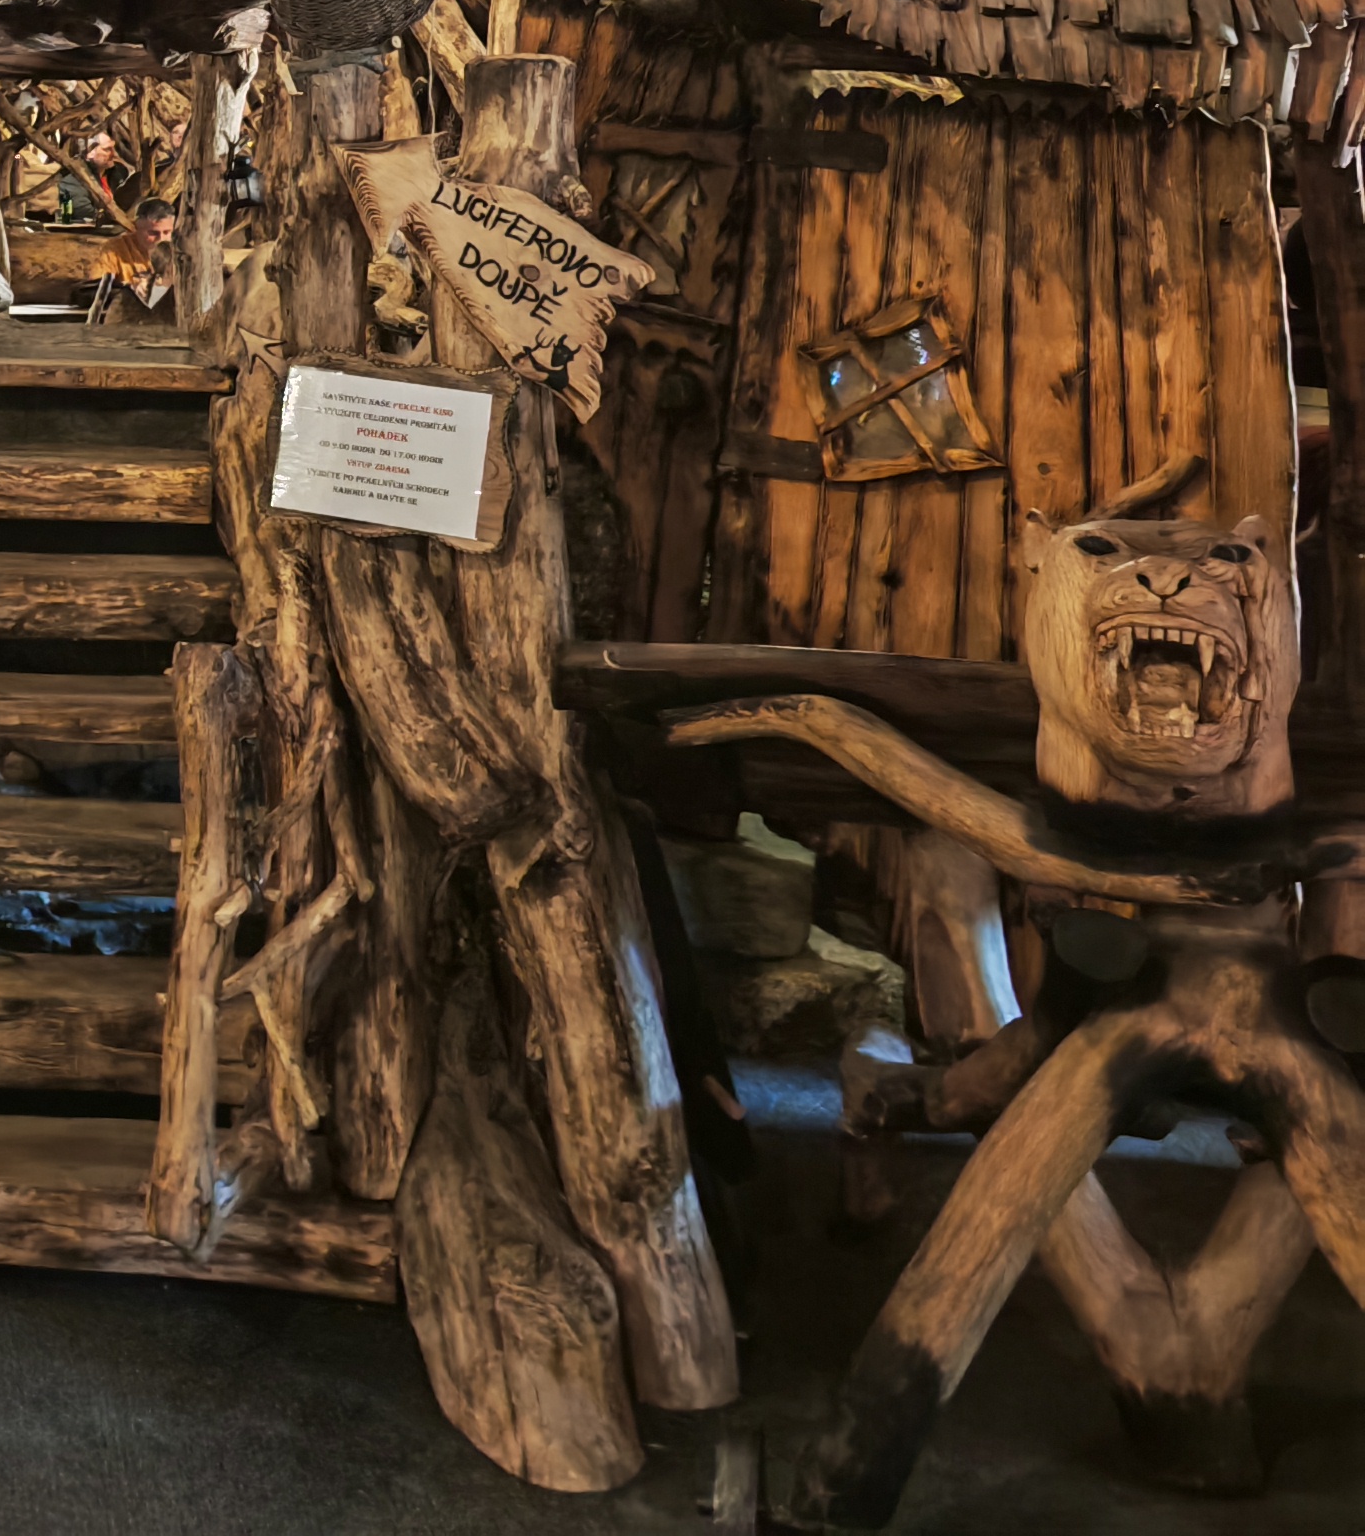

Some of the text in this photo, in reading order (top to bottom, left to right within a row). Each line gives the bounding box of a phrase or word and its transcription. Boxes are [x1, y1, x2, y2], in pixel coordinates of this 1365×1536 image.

[431, 182, 603, 288] LUCIFEROVO
[458, 242, 569, 325] DOUPĚ
[374, 463, 411, 475] ZDARMA
[368, 491, 375, 499] A
